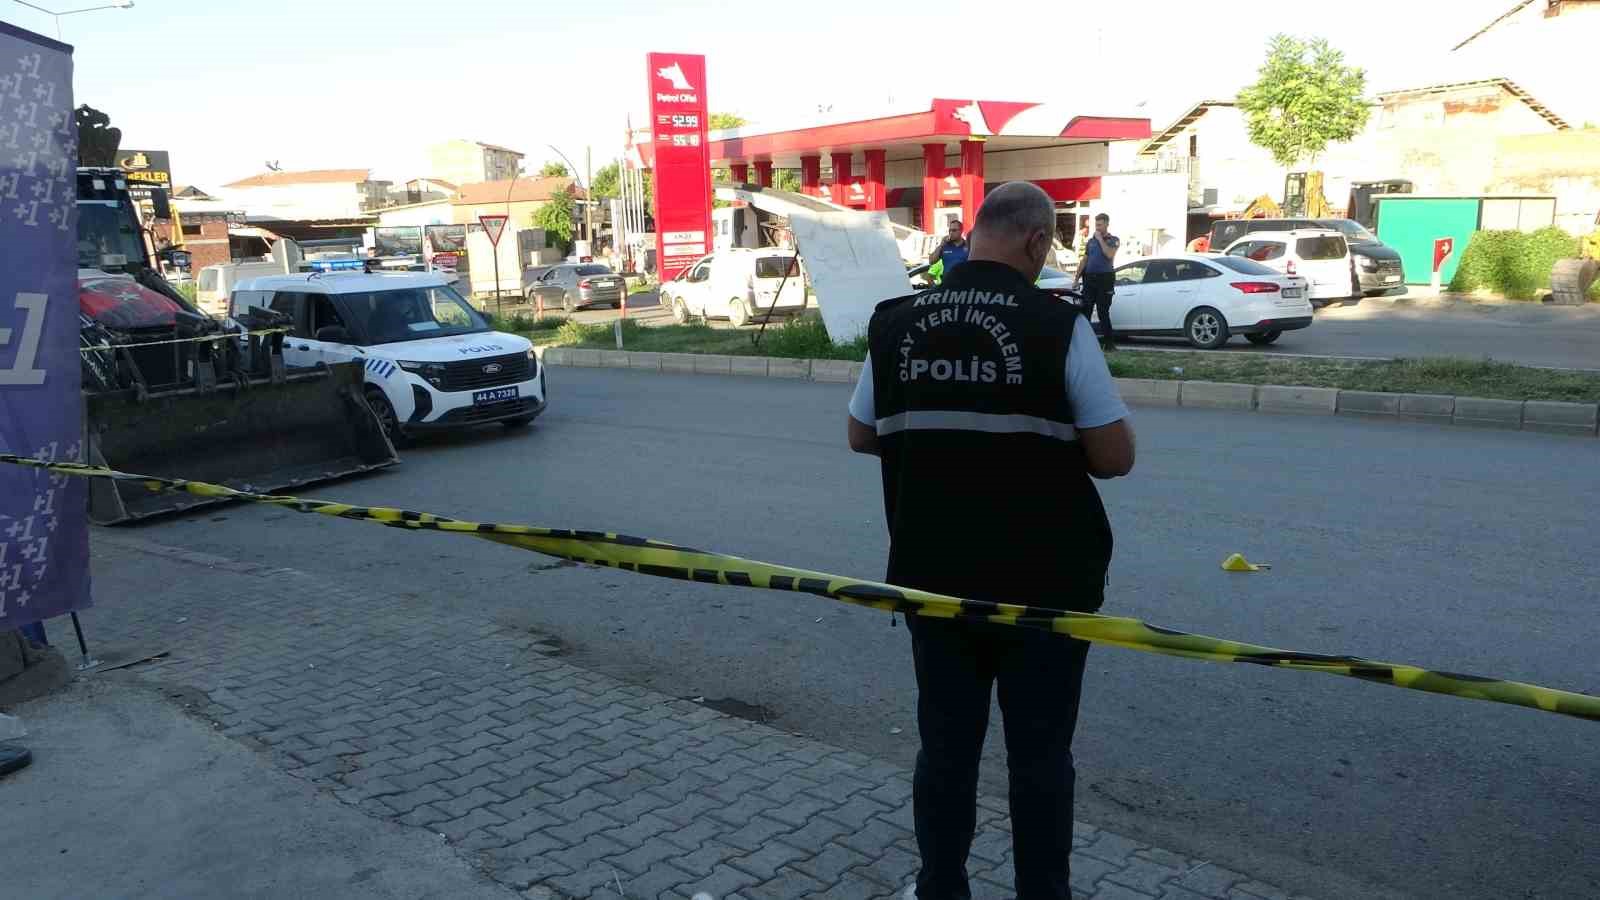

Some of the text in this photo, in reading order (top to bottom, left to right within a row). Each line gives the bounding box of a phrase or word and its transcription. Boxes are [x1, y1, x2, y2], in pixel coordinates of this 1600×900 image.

[18, 53, 41, 80] +1
[0, 72, 22, 99] +1
[32, 81, 56, 107] +1
[14, 101, 37, 128] +1
[48, 111, 71, 135] +1
[31, 130, 53, 155] +1
[12, 151, 37, 176] +1
[30, 178, 54, 204] +1
[13, 200, 38, 227] +1
[49, 204, 69, 230] +1
[899, 331, 915, 381] OLAY
[915, 304, 959, 332] YERİ
[910, 355, 998, 382] POLİS
[477, 393, 488, 401] 44
[489, 392, 496, 400] A
[5, 515, 36, 542] +1
[19, 536, 48, 563] +1
[0, 564, 23, 590] +1
